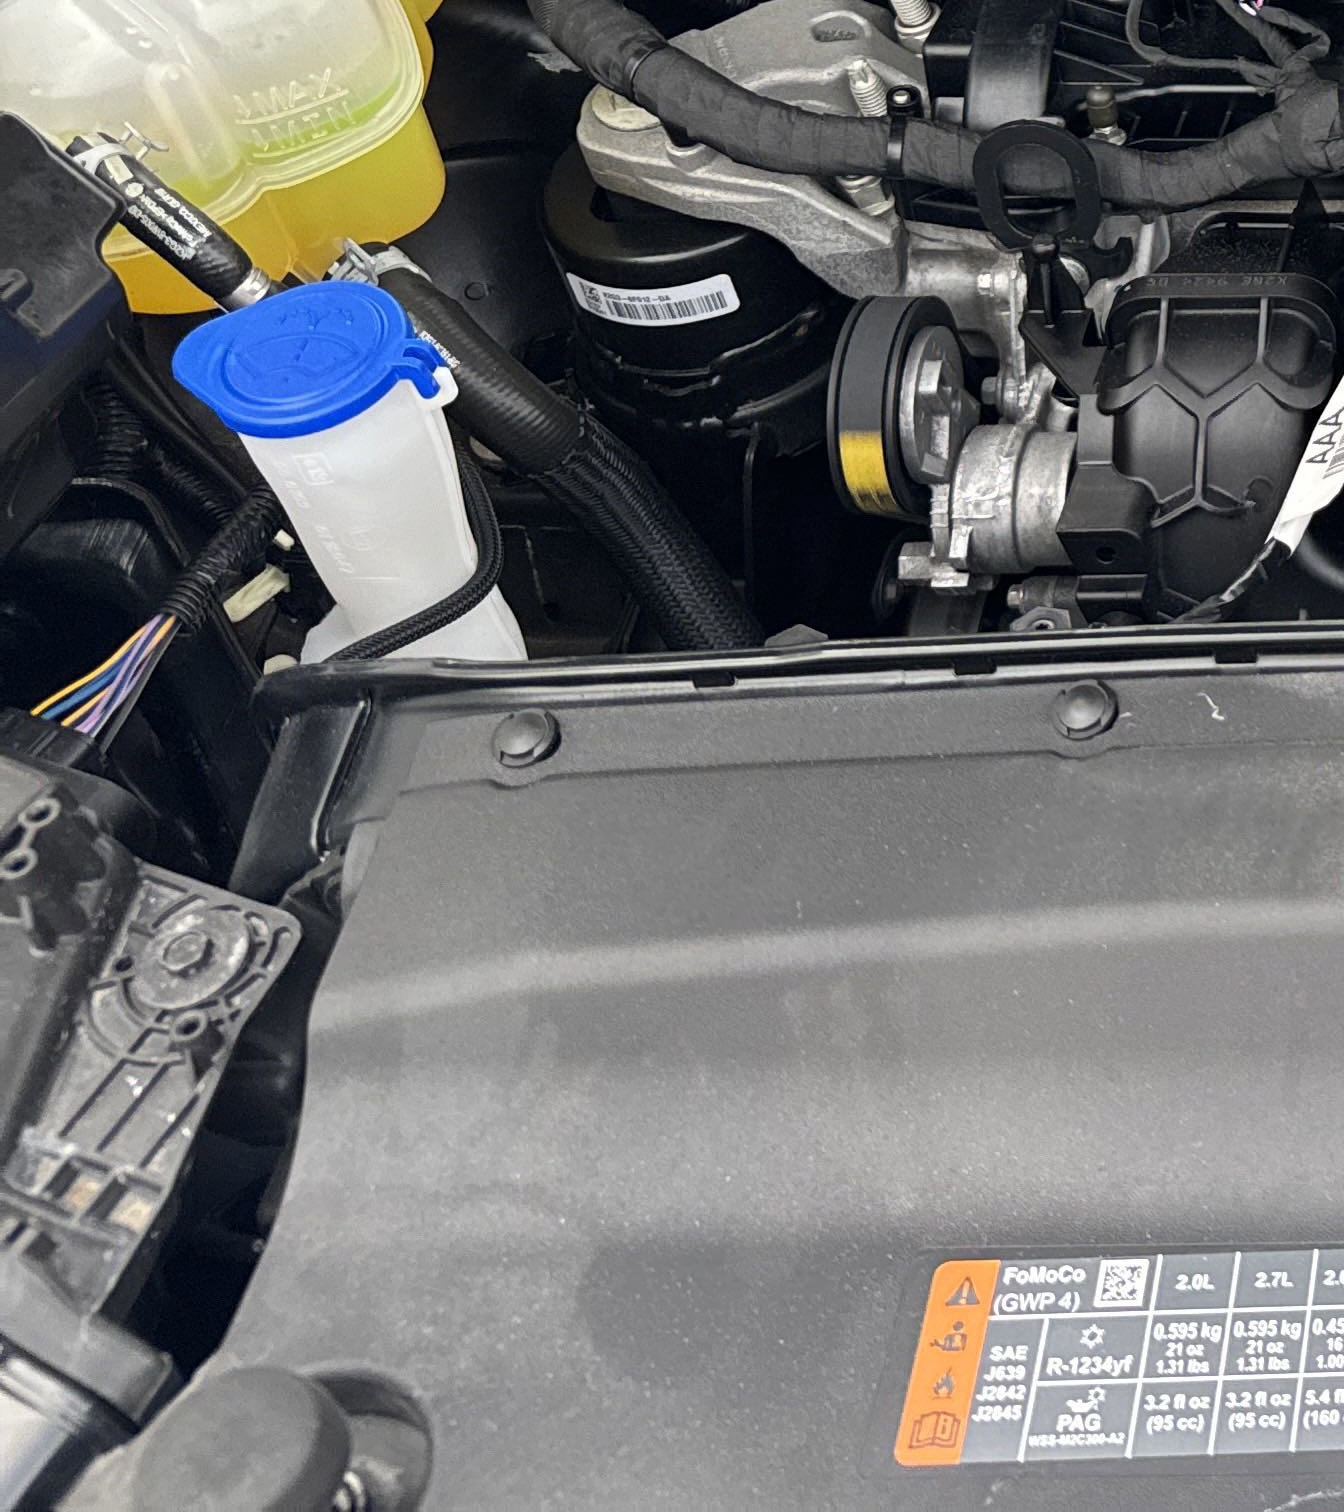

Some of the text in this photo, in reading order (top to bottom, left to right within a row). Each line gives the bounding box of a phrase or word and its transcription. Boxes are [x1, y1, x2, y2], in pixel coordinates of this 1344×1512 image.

[252, 67, 342, 115] MAX
[269, 100, 357, 148] MIN
[1003, 1265, 1087, 1285] FoMoCo
[1175, 1273, 1215, 1291] 2.0L
[1254, 1272, 1294, 1288] 2.7L
[993, 1292, 1080, 1316] (GWP 4)
[1153, 1321, 1223, 1343] 0.595 kg
[1233, 1319, 1302, 1340] 0.595 kg
[989, 1345, 1028, 1362] SAE
[1166, 1342, 1205, 1357] 21 oz
[1246, 1340, 1285, 1355] 21 oz
[1326, 1338, 1342, 1352] 16
[1046, 1355, 1134, 1376] R-1234yf
[1156, 1359, 1209, 1375] 1.31 lbs
[1236, 1357, 1290, 1372] 1.31 lbs
[1316, 1355, 1344, 1369] 1.00
[984, 1366, 1026, 1382] J639
[975, 1385, 1026, 1402] J2842
[1143, 1392, 1211, 1411] 3.2 fl oz
[1225, 1390, 1292, 1409] 3.2 fl oz
[1304, 1389, 1332, 1406] 5.4
[1056, 1414, 1101, 1432] PAG
[1146, 1413, 1205, 1435] (95 cc)
[1228, 1410, 1286, 1432] (95 cc)
[1303, 1410, 1340, 1430] (160
